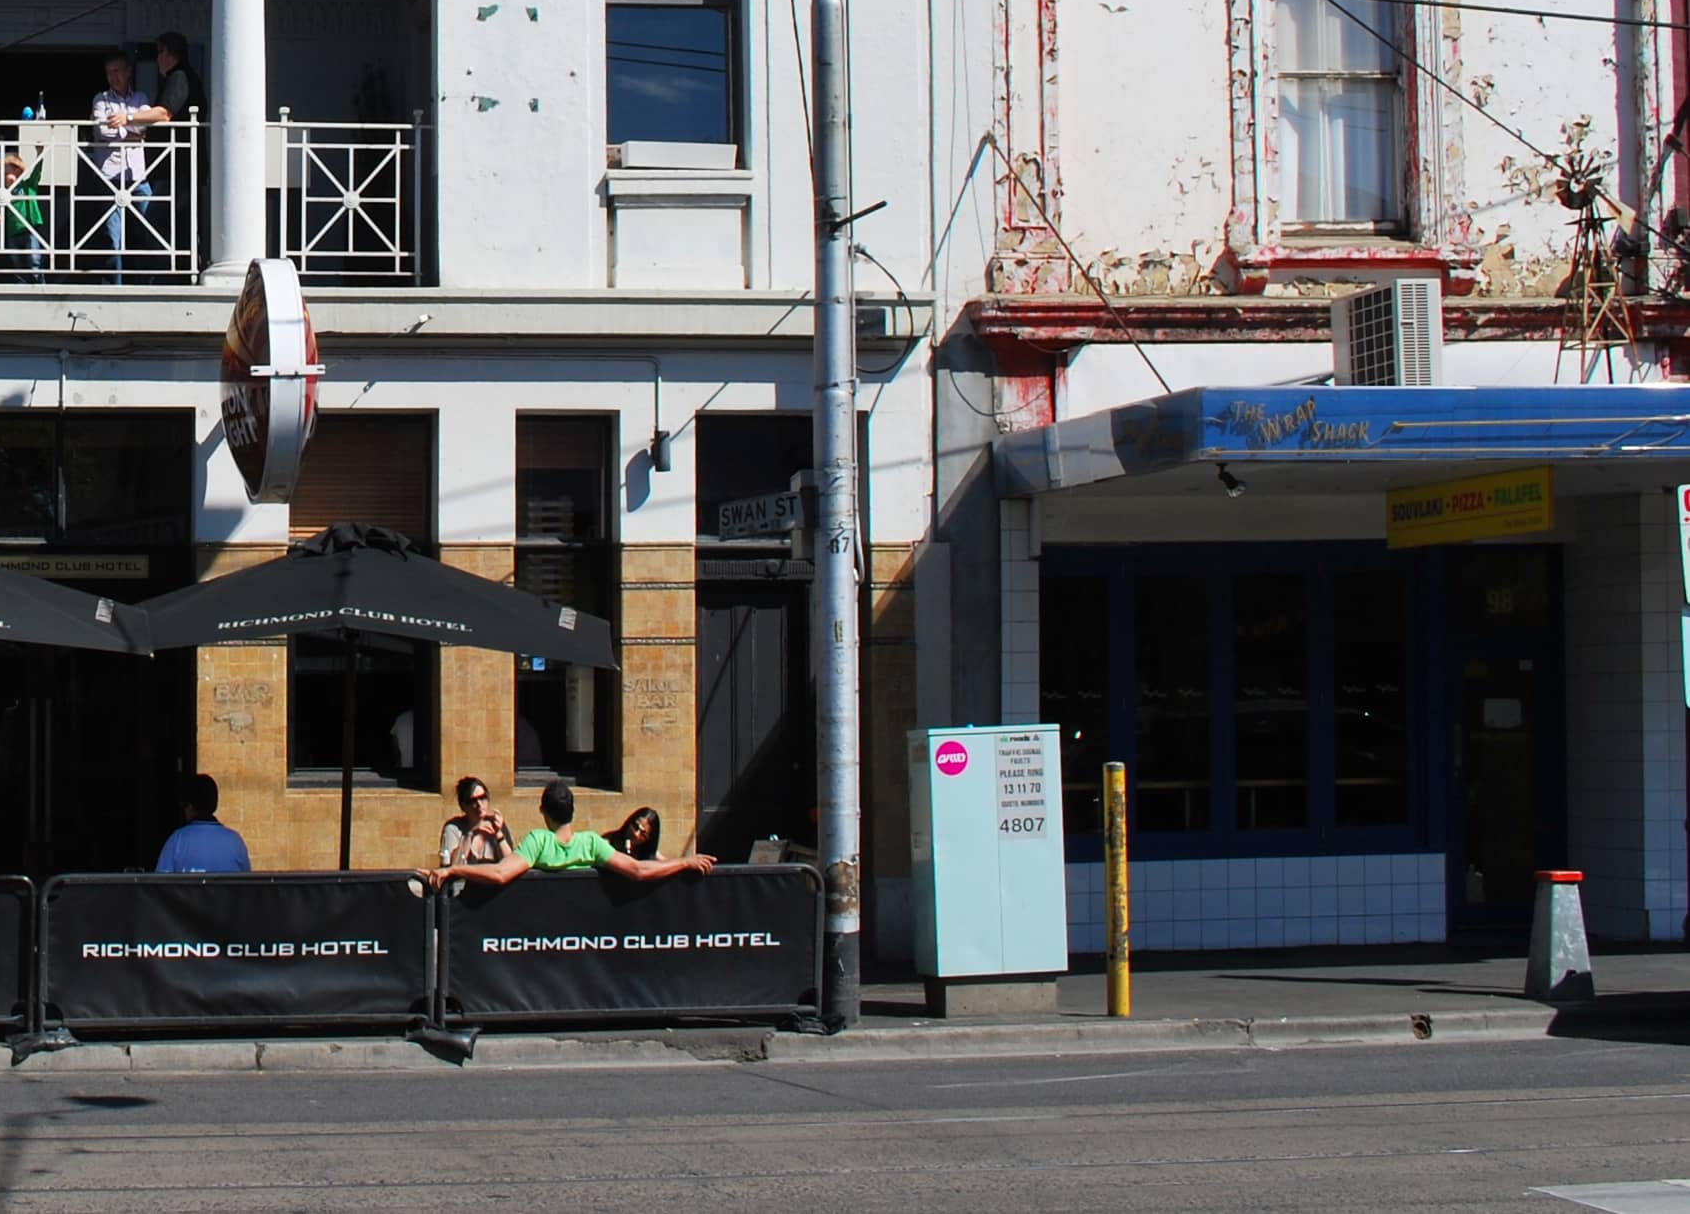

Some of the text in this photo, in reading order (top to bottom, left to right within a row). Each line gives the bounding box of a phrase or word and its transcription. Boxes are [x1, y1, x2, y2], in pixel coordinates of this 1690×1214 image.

[1232, 400, 1266, 423] THE
[721, 498, 767, 527] SWAN
[775, 496, 797, 516] ST
[1452, 491, 1484, 513] PIZZA
[55, 561, 91, 571] CLUB
[95, 561, 141, 571] HOTEL
[217, 607, 473, 632] RICHMOND CLUB HOTEL
[999, 769, 1025, 779] PLEASE
[1004, 783, 1041, 794] 13 11 70
[999, 817, 1045, 833] 4807
[82, 940, 389, 958] RICHMOND CLUB HOTEL
[482, 932, 780, 952] RICHMOND CLUB HOTEL
